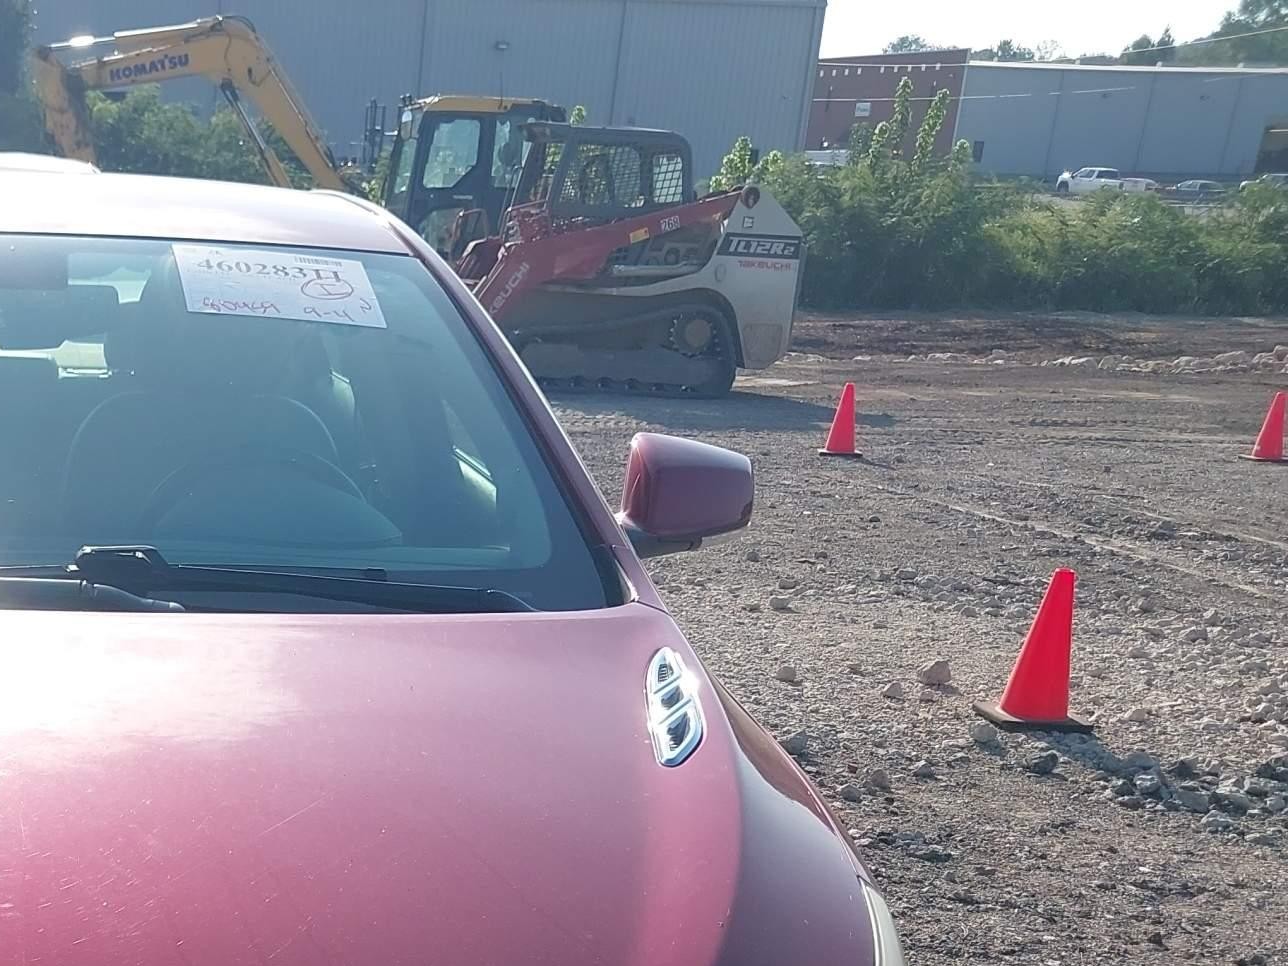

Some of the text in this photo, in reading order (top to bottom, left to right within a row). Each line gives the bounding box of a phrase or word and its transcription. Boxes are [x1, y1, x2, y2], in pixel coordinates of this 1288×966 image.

[109, 54, 189, 81] KOMATSU
[729, 238, 795, 256] TL12R2
[196, 258, 341, 283] 46028311
